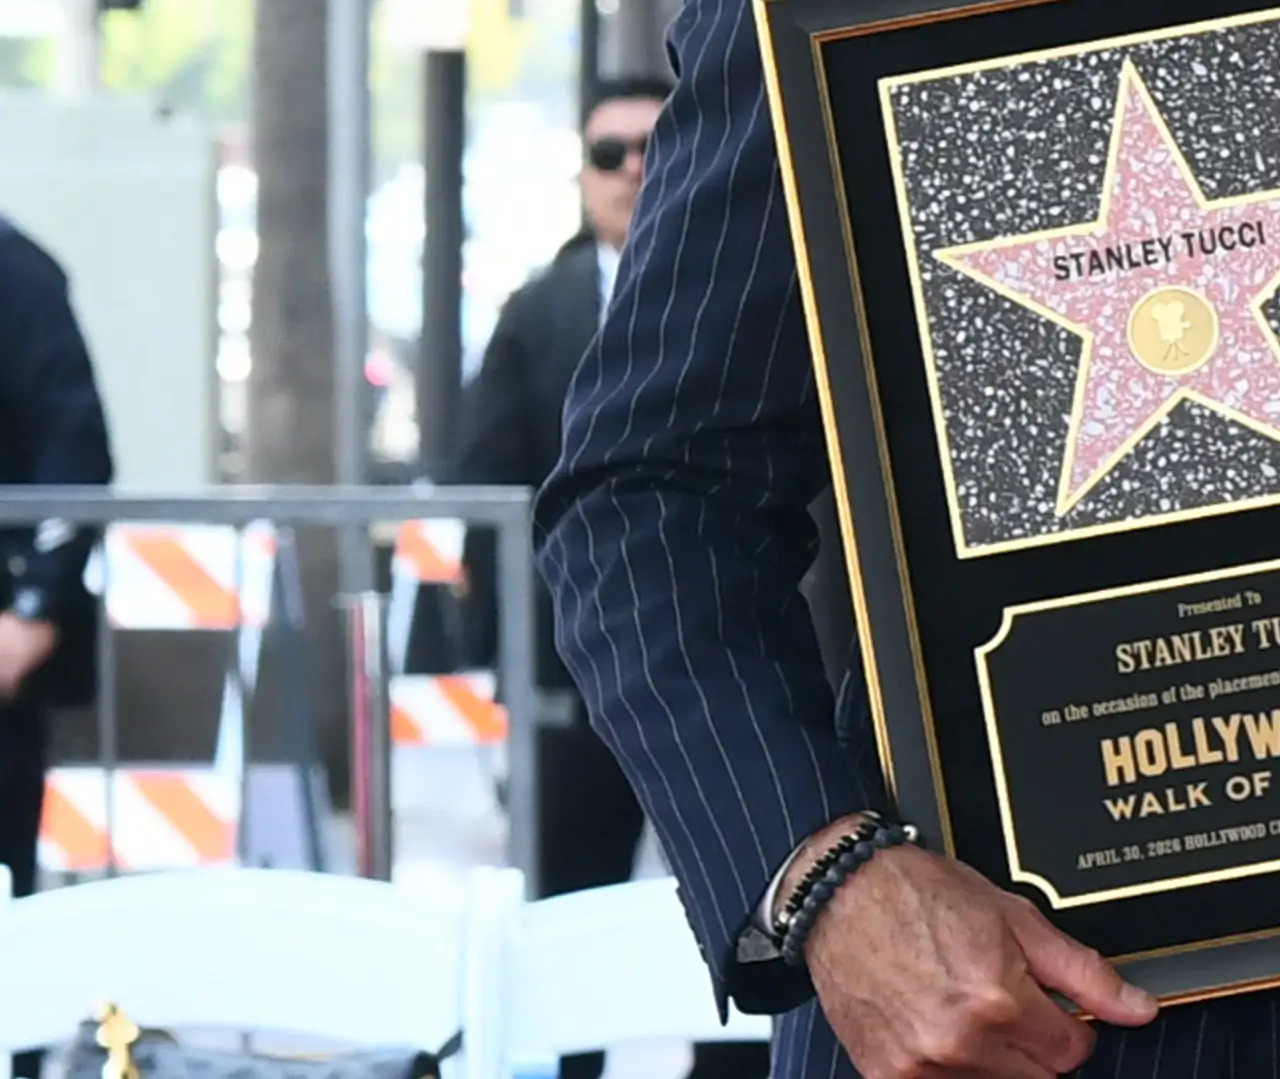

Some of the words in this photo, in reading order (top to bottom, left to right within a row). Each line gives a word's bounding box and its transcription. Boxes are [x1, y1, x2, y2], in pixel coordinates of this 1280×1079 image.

[1053, 235, 1173, 281] STANLEY
[1181, 220, 1266, 258] TUCCI
[1177, 593, 1242, 618] Presented
[1244, 591, 1262, 605] To
[1115, 623, 1246, 674] STANLEY
[1041, 709, 1061, 726] on
[1064, 703, 1090, 721] the
[1092, 692, 1159, 717] occasion
[1161, 686, 1178, 705] of
[1179, 682, 1206, 701] the
[1103, 782, 1213, 822] WALK
[1225, 770, 1272, 802] OF
[1077, 848, 1121, 870] APRIL
[1147, 837, 1183, 858] 2026
[1184, 822, 1267, 851] HOLLYWOOD
